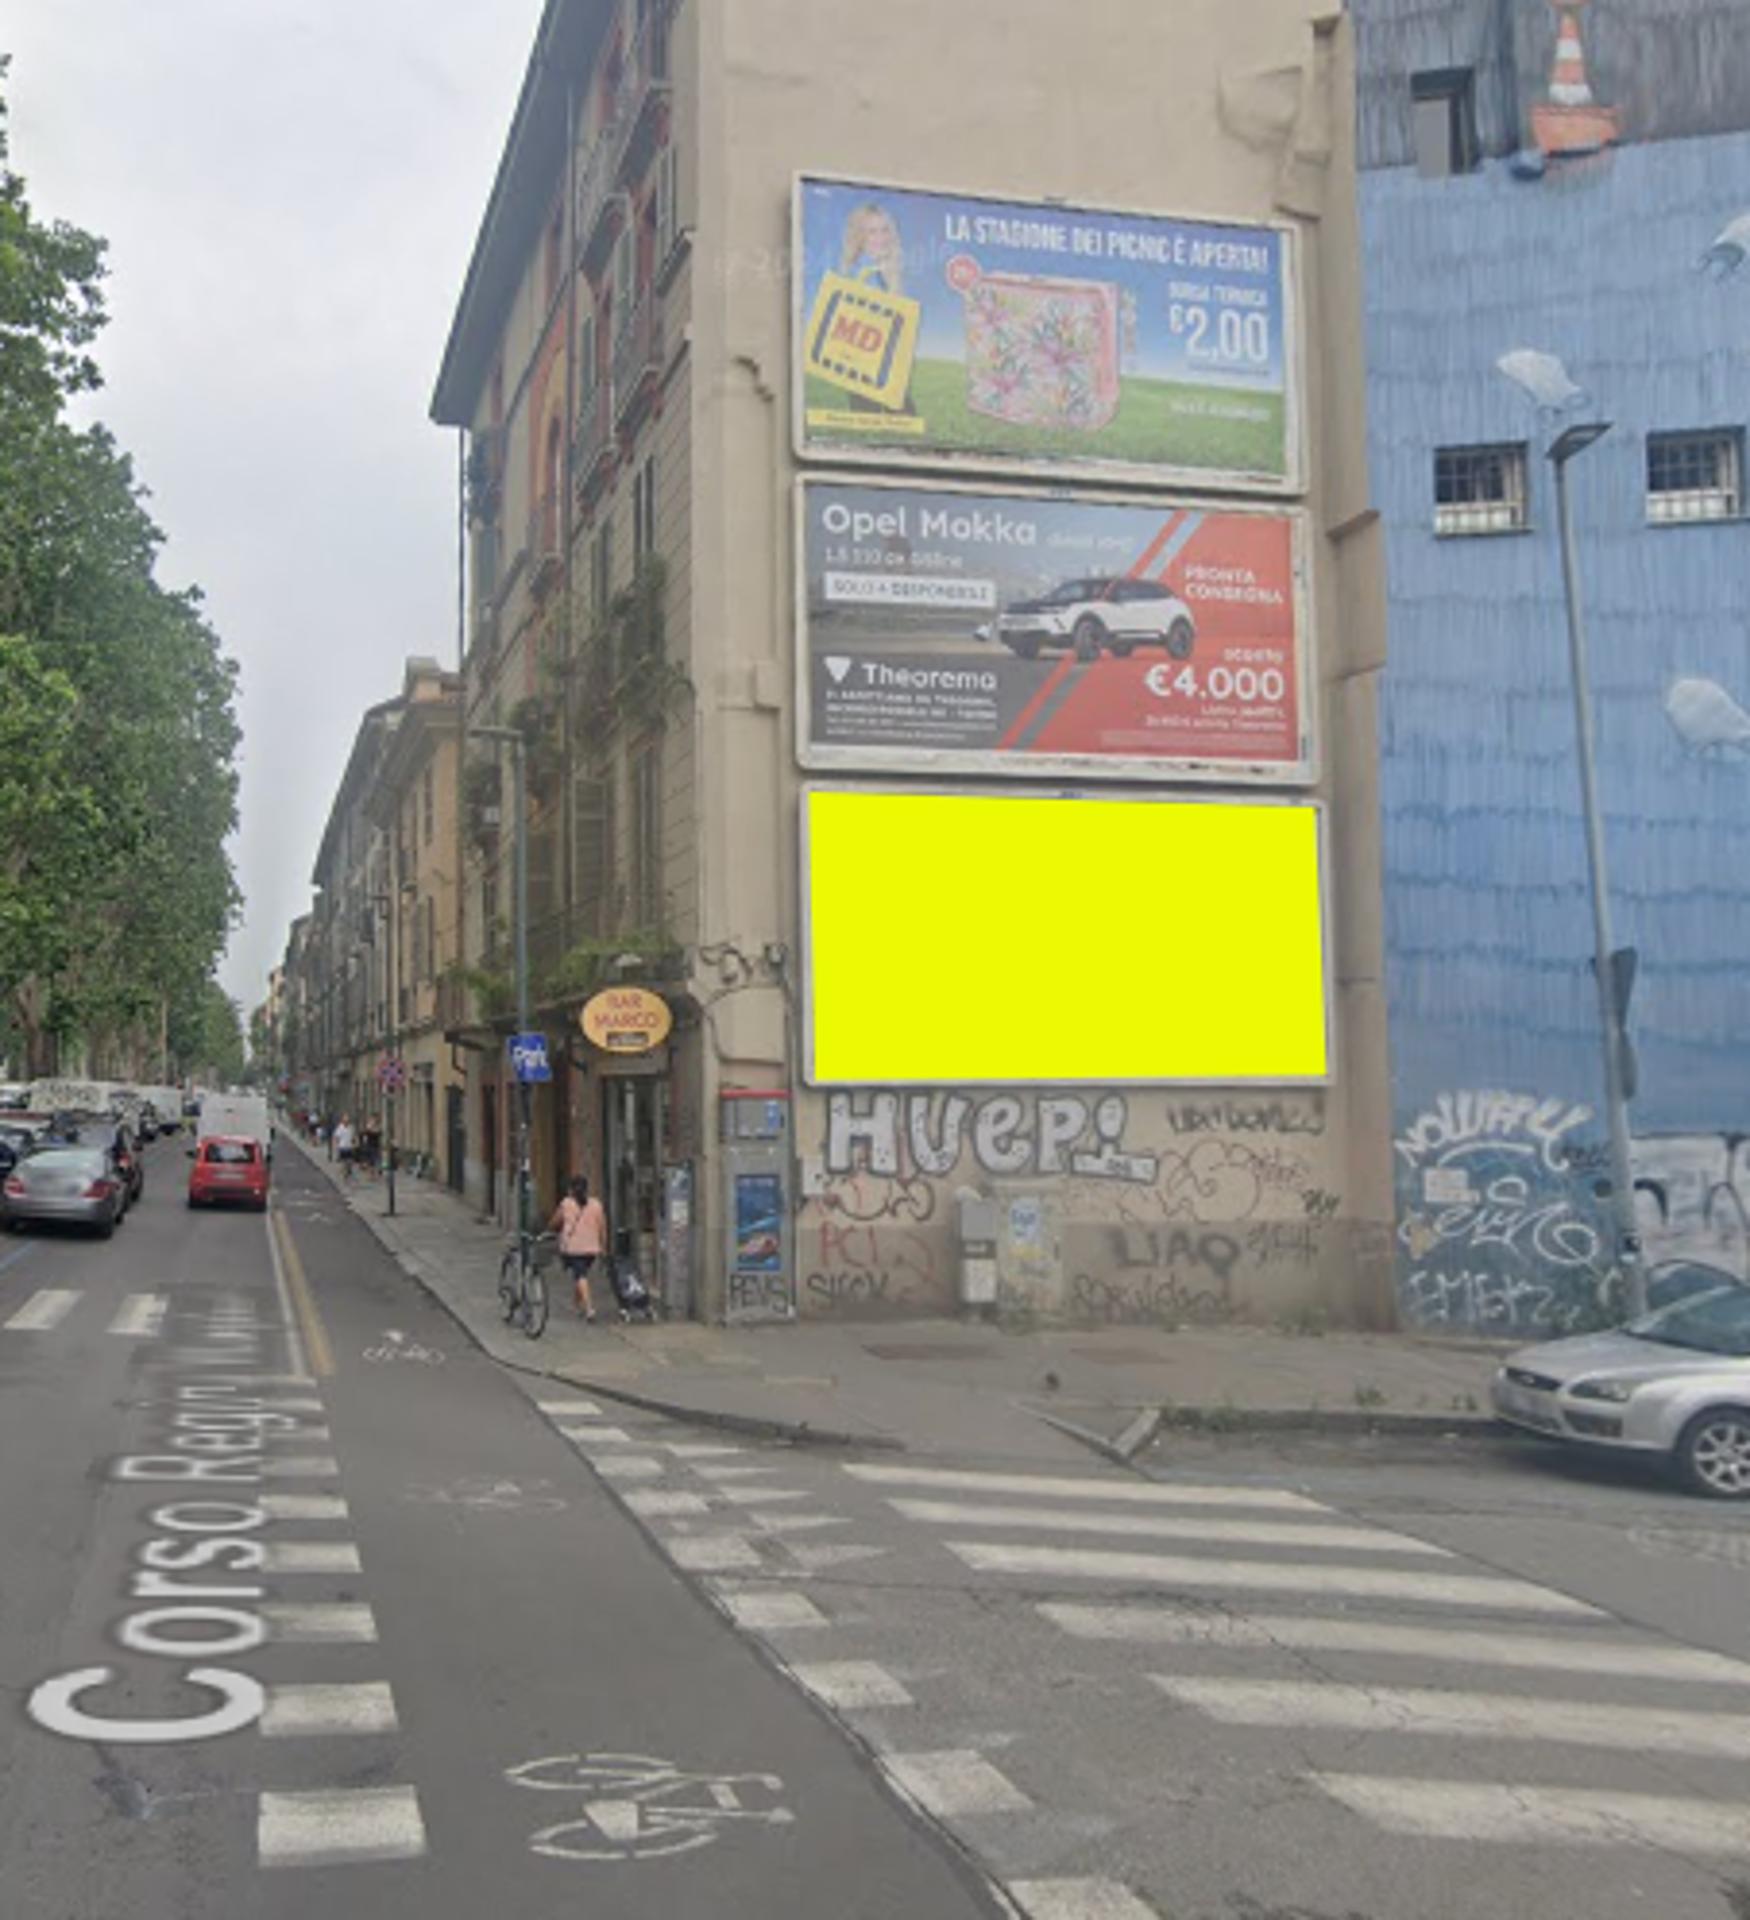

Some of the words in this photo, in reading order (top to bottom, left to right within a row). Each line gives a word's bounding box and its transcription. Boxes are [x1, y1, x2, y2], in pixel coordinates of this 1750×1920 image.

[945, 213, 969, 242] LA
[975, 217, 1067, 254] STAGIONE
[1073, 227, 1102, 256] DEI
[1108, 230, 1169, 264] PICNIC
[1190, 239, 1267, 274] APERTA!
[830, 312, 884, 356] MD
[822, 503, 907, 542] Opel
[921, 509, 1037, 546] Mokka
[1185, 565, 1255, 584] PRONTA
[1185, 583, 1283, 605] CONSEGNA
[861, 664, 998, 690] Theorema
[1145, 664, 1284, 701] €4.000
[606, 993, 642, 1009] BAR
[594, 1012, 661, 1029] MARCO
